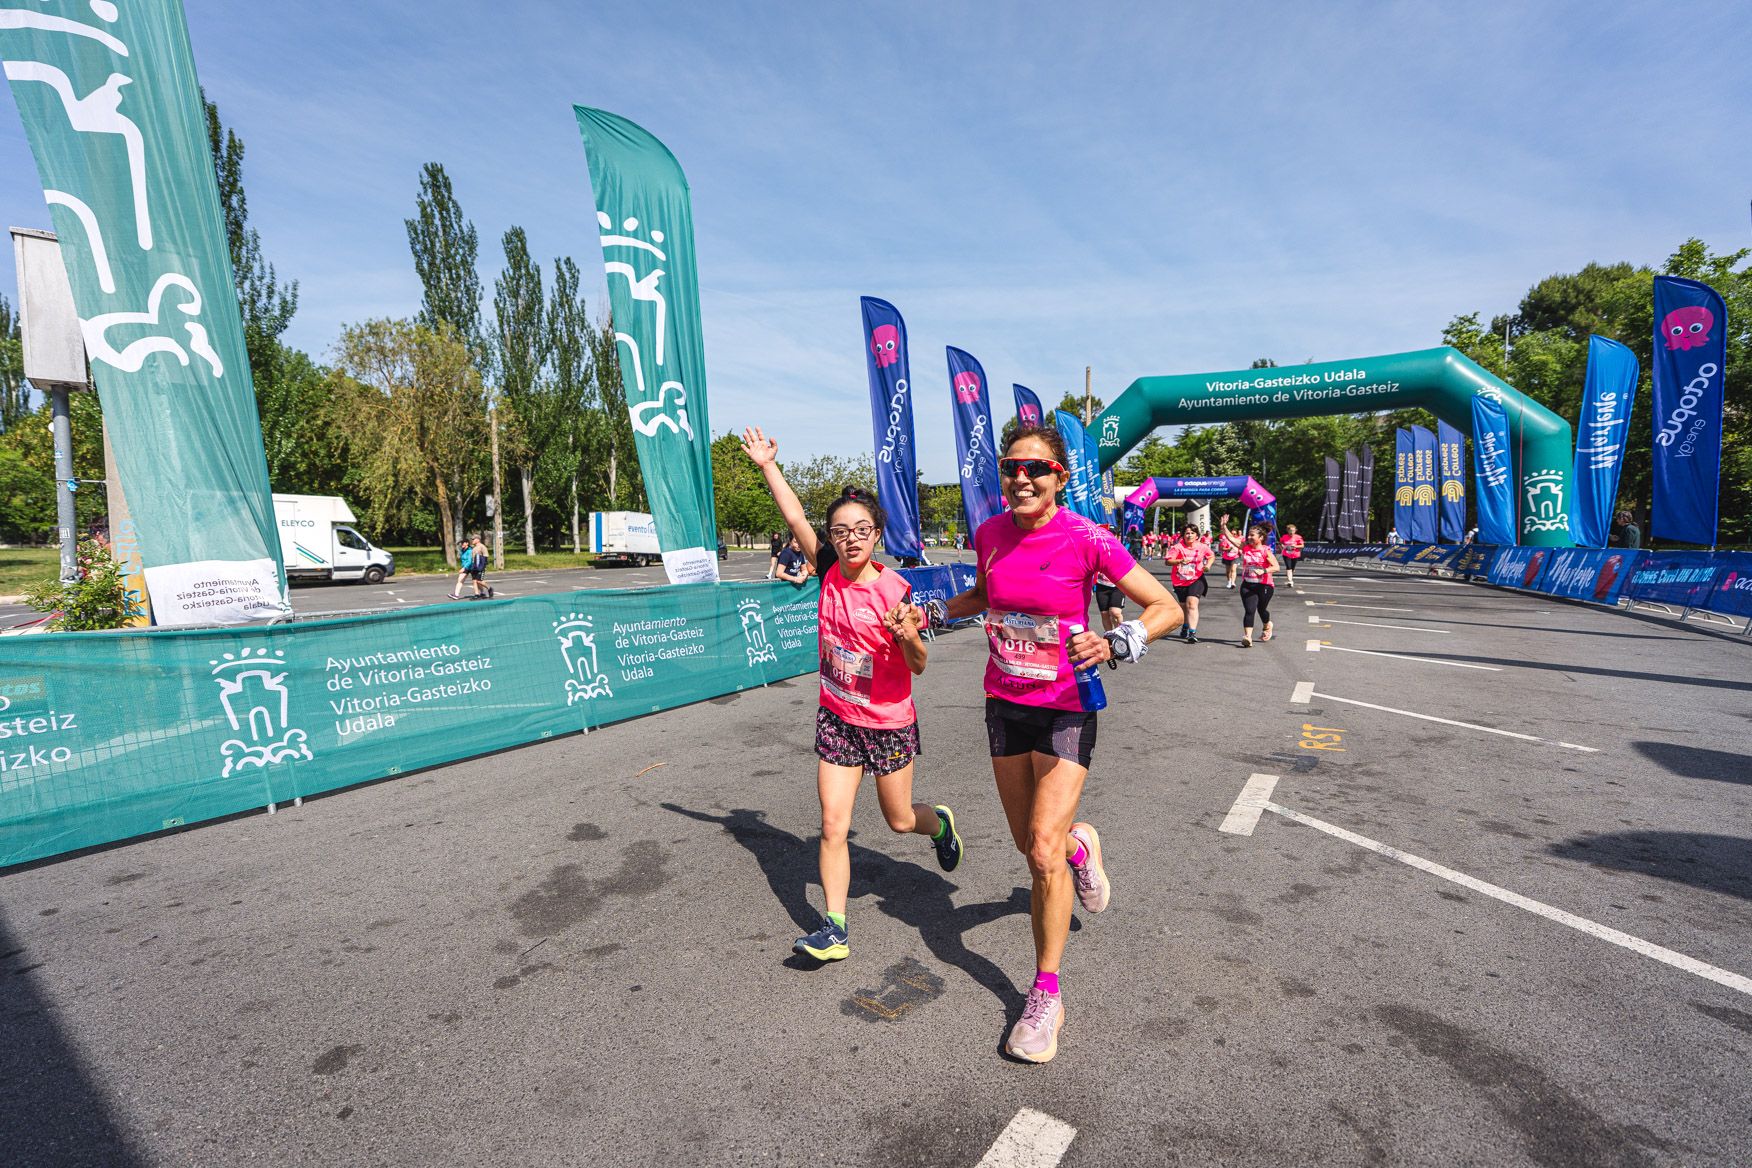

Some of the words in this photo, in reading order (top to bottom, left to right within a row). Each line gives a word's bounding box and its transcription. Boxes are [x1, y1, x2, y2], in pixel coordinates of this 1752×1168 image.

[1206, 373, 1320, 393] Vitoria-Gasteizko
[1324, 369, 1366, 383] Udala
[1178, 393, 1269, 411] Ayuntamiento
[1273, 391, 1290, 403] de
[1293, 381, 1400, 401] Vitoria-Gasteiz
[281, 519, 315, 528] ELEYCO
[1549, 550, 1595, 595] Marlene
[772, 601, 818, 613] Ayuntamiento
[612, 617, 687, 637] Ayuntamiento
[774, 615, 784, 625] de
[785, 611, 819, 624] Vitoria-Ga
[615, 637, 629, 649] de
[631, 628, 704, 647] Vitoria-Gasteiz
[781, 640, 801, 650] Udala
[1005, 639, 1035, 653] 016
[325, 644, 460, 675] Ayuntamiento
[617, 644, 705, 667] Vitoria-Gasteizko
[326, 673, 353, 692] de
[358, 655, 493, 686] Vitoria-Gasteiz
[622, 666, 654, 682] Udala
[832, 668, 852, 684] 016
[330, 677, 492, 715] Vitoria-Gasteizko
[335, 712, 395, 736] Udala
